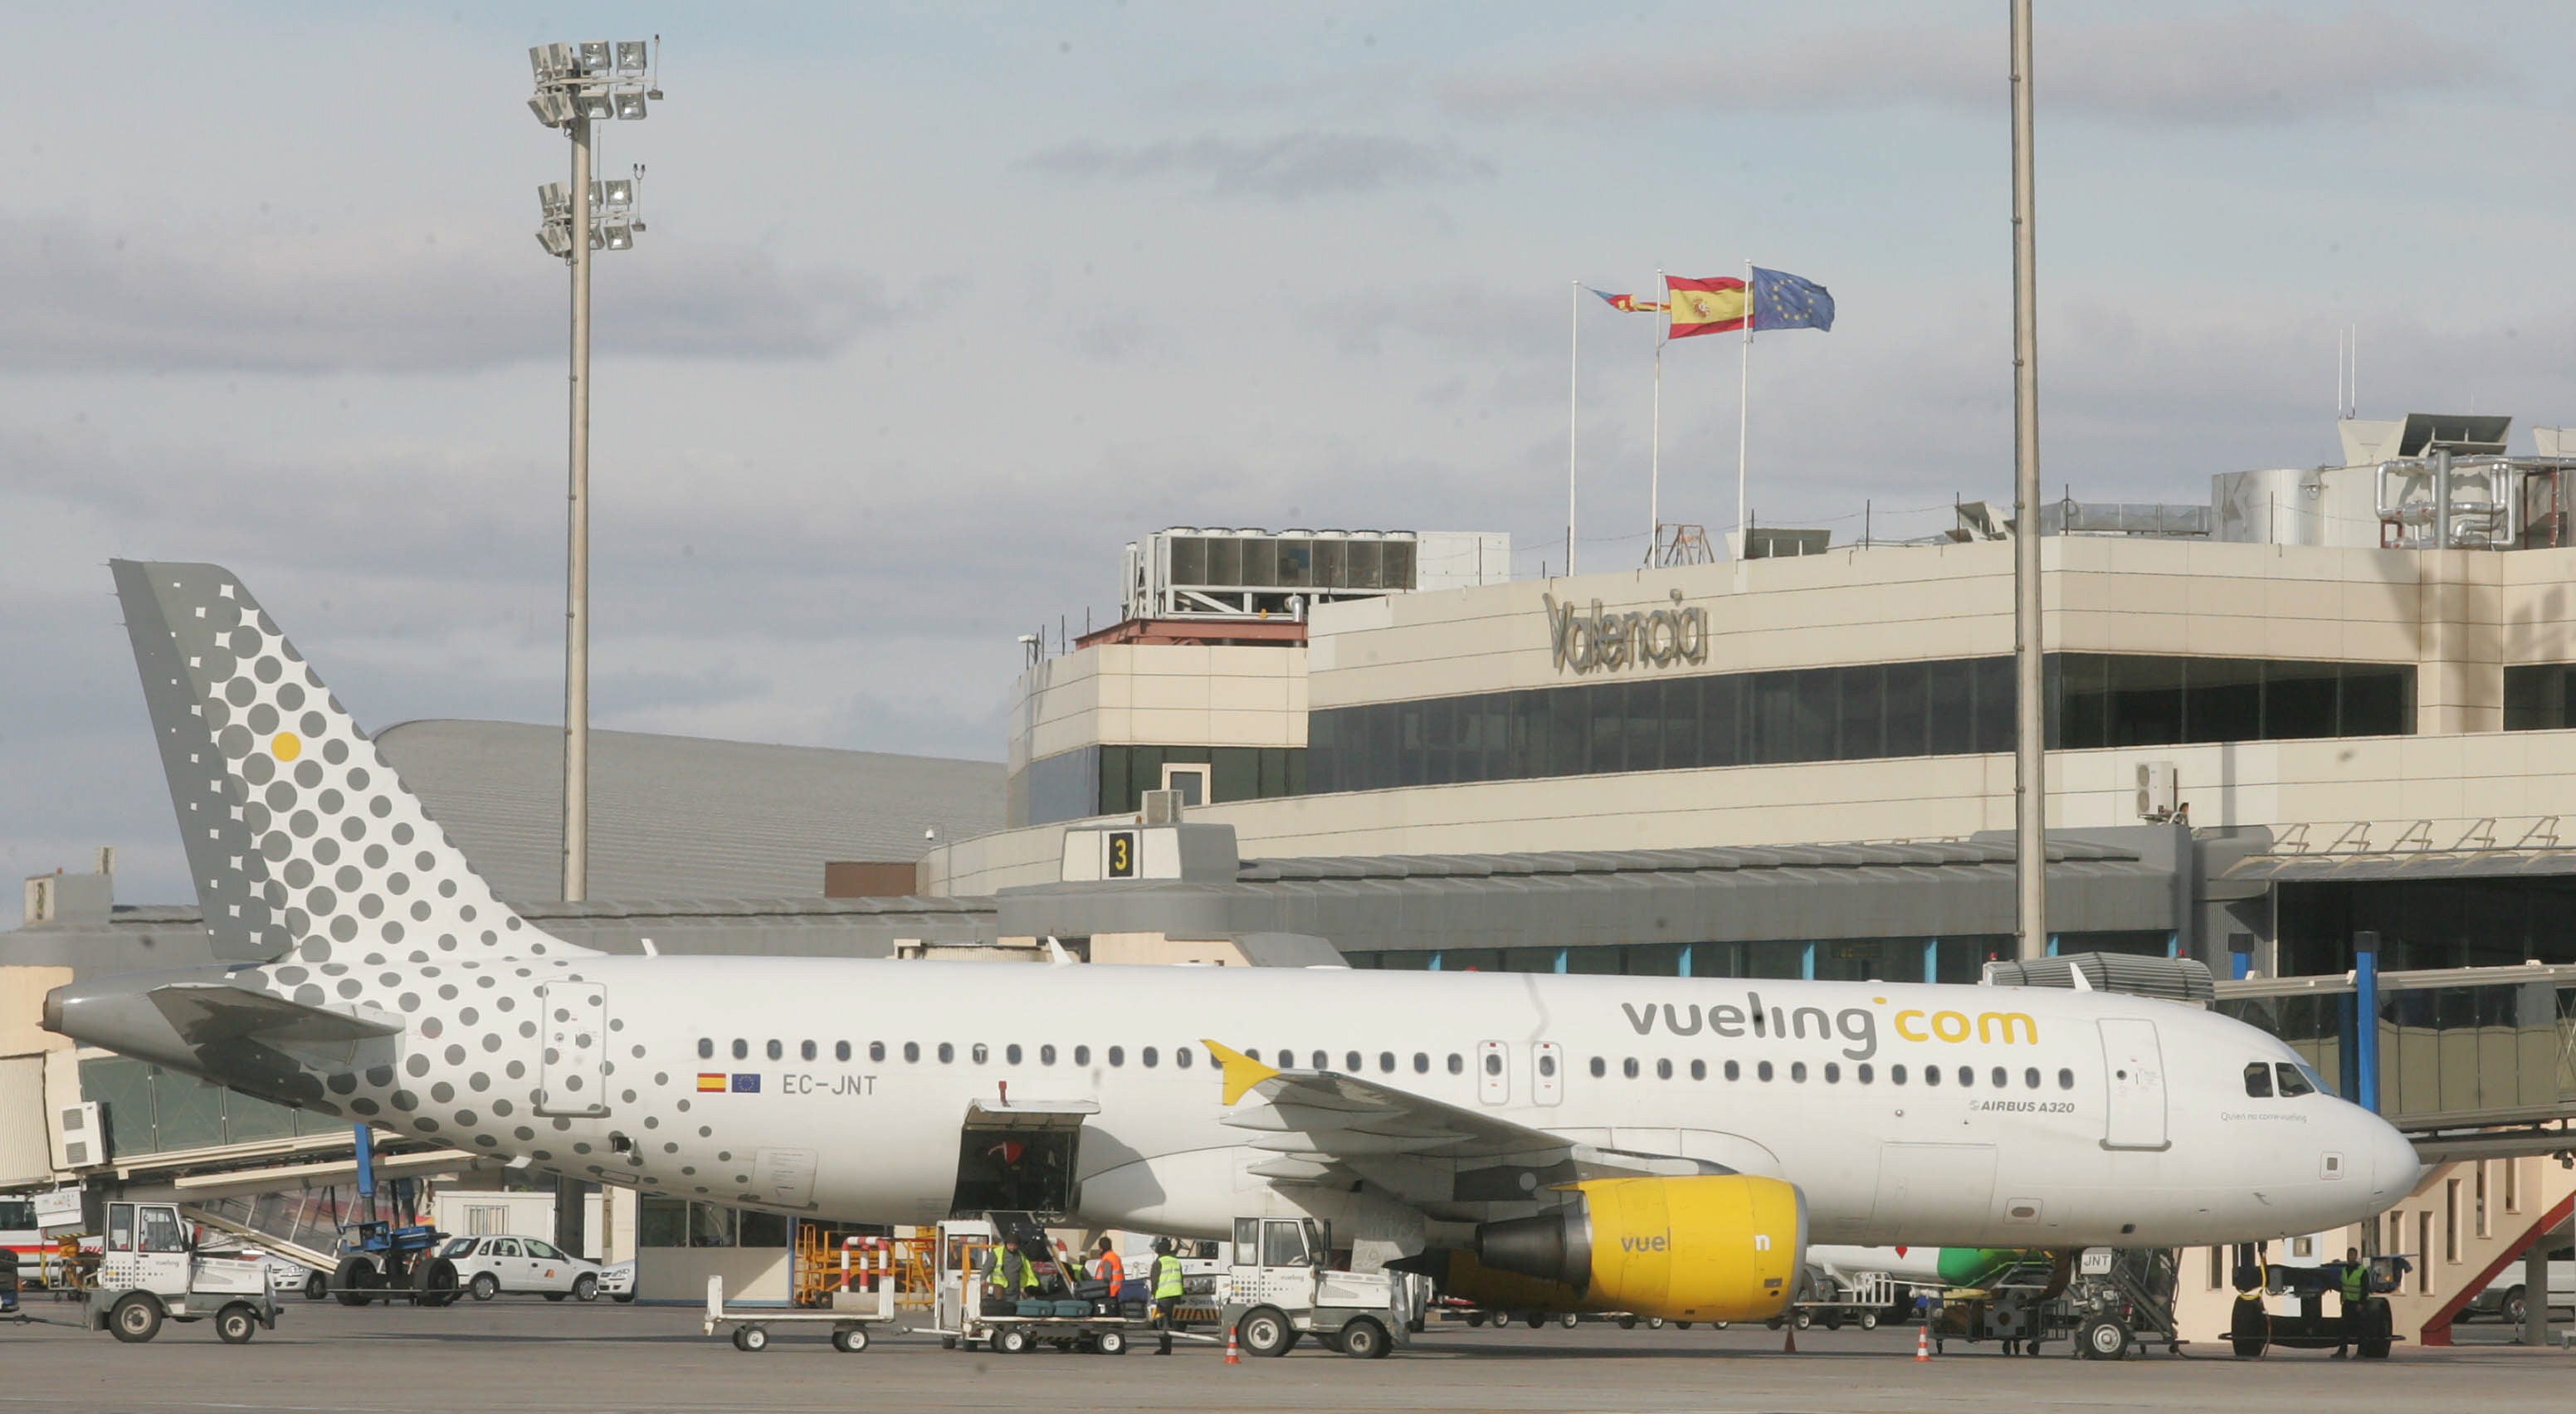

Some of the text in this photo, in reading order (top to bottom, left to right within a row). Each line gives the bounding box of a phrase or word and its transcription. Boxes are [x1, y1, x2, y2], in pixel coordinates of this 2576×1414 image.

[1542, 588, 1708, 675] Valencia
[1115, 839, 1126, 870] 3
[783, 1074, 877, 1095] EC-JNT
[1980, 1100, 2075, 1114] AIRBUS A320
[2084, 1255, 2110, 1267] JNT
